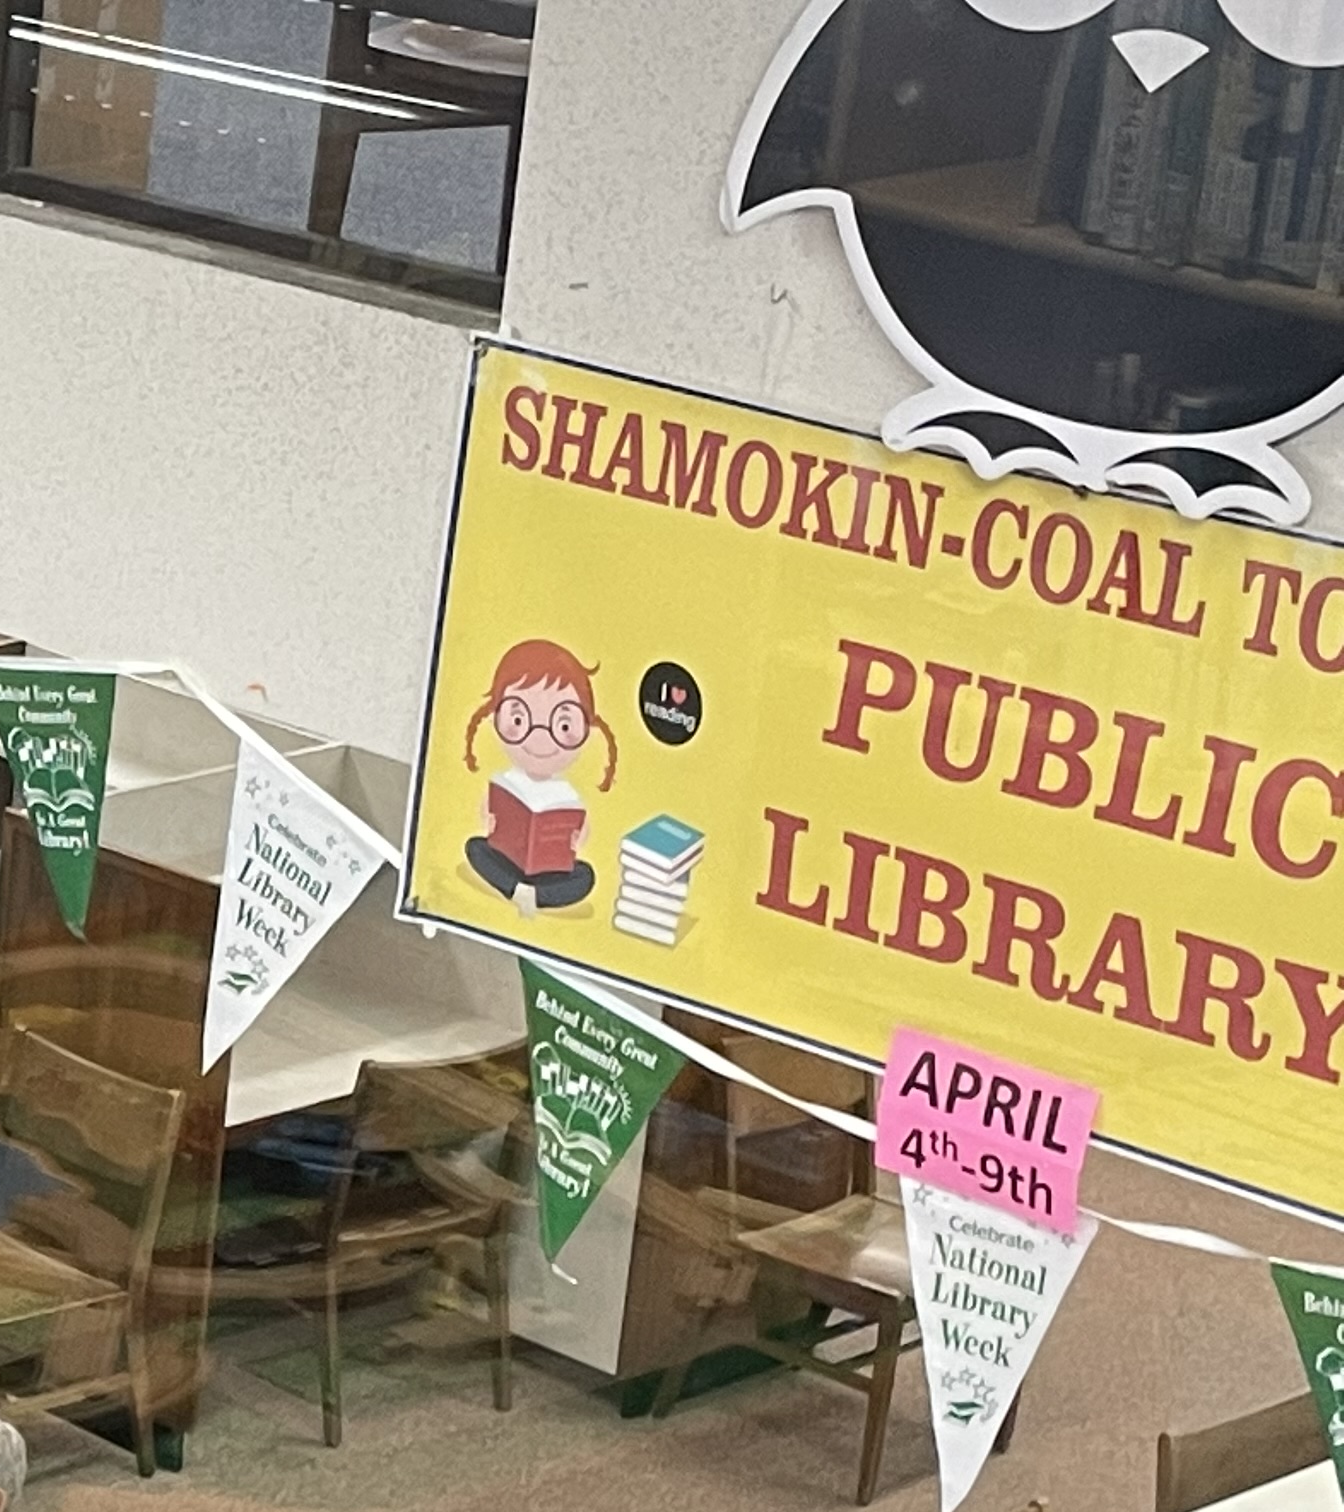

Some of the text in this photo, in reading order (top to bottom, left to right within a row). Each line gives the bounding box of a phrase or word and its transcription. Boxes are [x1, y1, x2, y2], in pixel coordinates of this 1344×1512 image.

[501, 385, 1206, 638] SHAMOKIN-COAL
[821, 638, 1344, 879] PUBLIC
[237, 857, 315, 936] Library
[245, 823, 332, 906] National
[235, 898, 290, 958] Week
[754, 807, 1344, 1087] LIBRARY
[536, 990, 580, 1028] Behind
[899, 1050, 1069, 1155] APRIL
[929, 1232, 1047, 1295] National
[949, 1215, 1035, 1252] Celebrate
[931, 1272, 1037, 1339] Library
[941, 1318, 1013, 1367] Week
